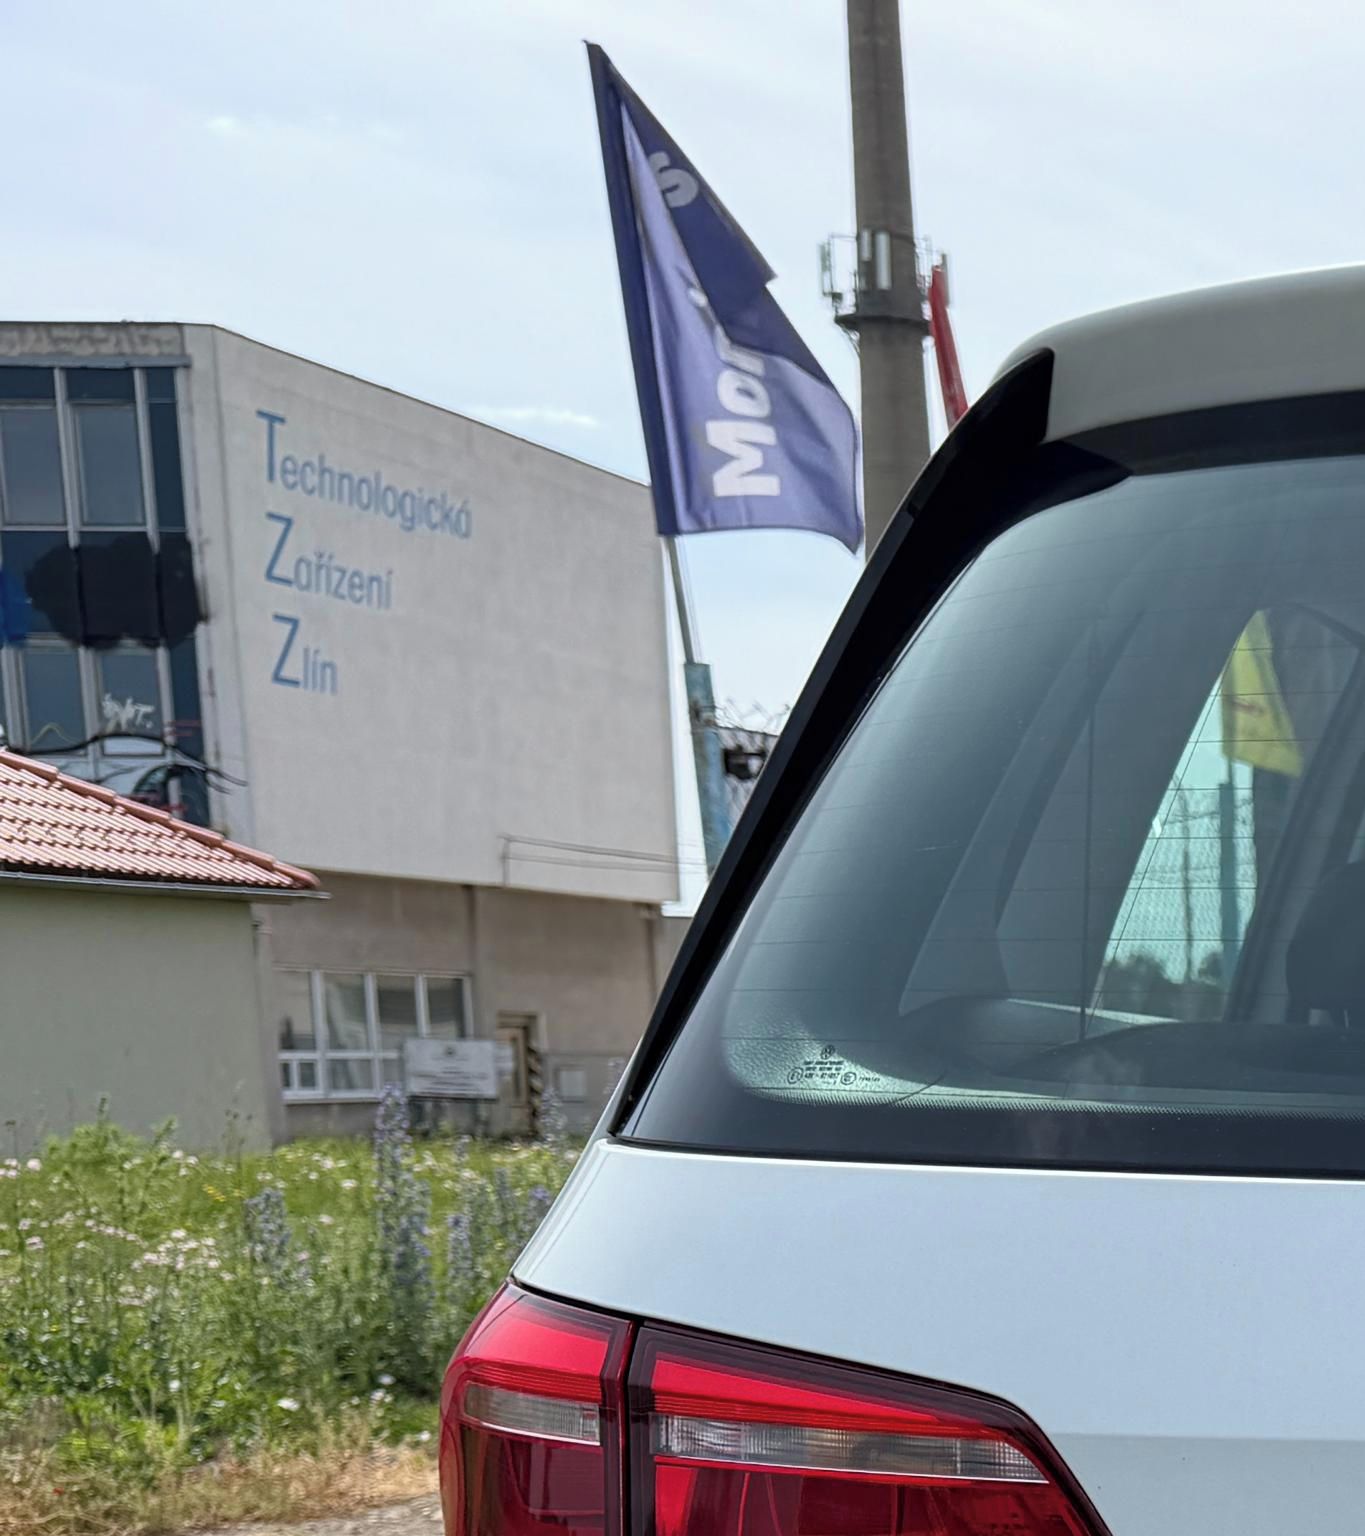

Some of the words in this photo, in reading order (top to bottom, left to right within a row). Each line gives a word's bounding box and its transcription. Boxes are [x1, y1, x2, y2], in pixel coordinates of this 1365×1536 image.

[256, 408, 472, 539] Technologická
[265, 511, 393, 609] Zařízení
[271, 612, 338, 694] Zlín
